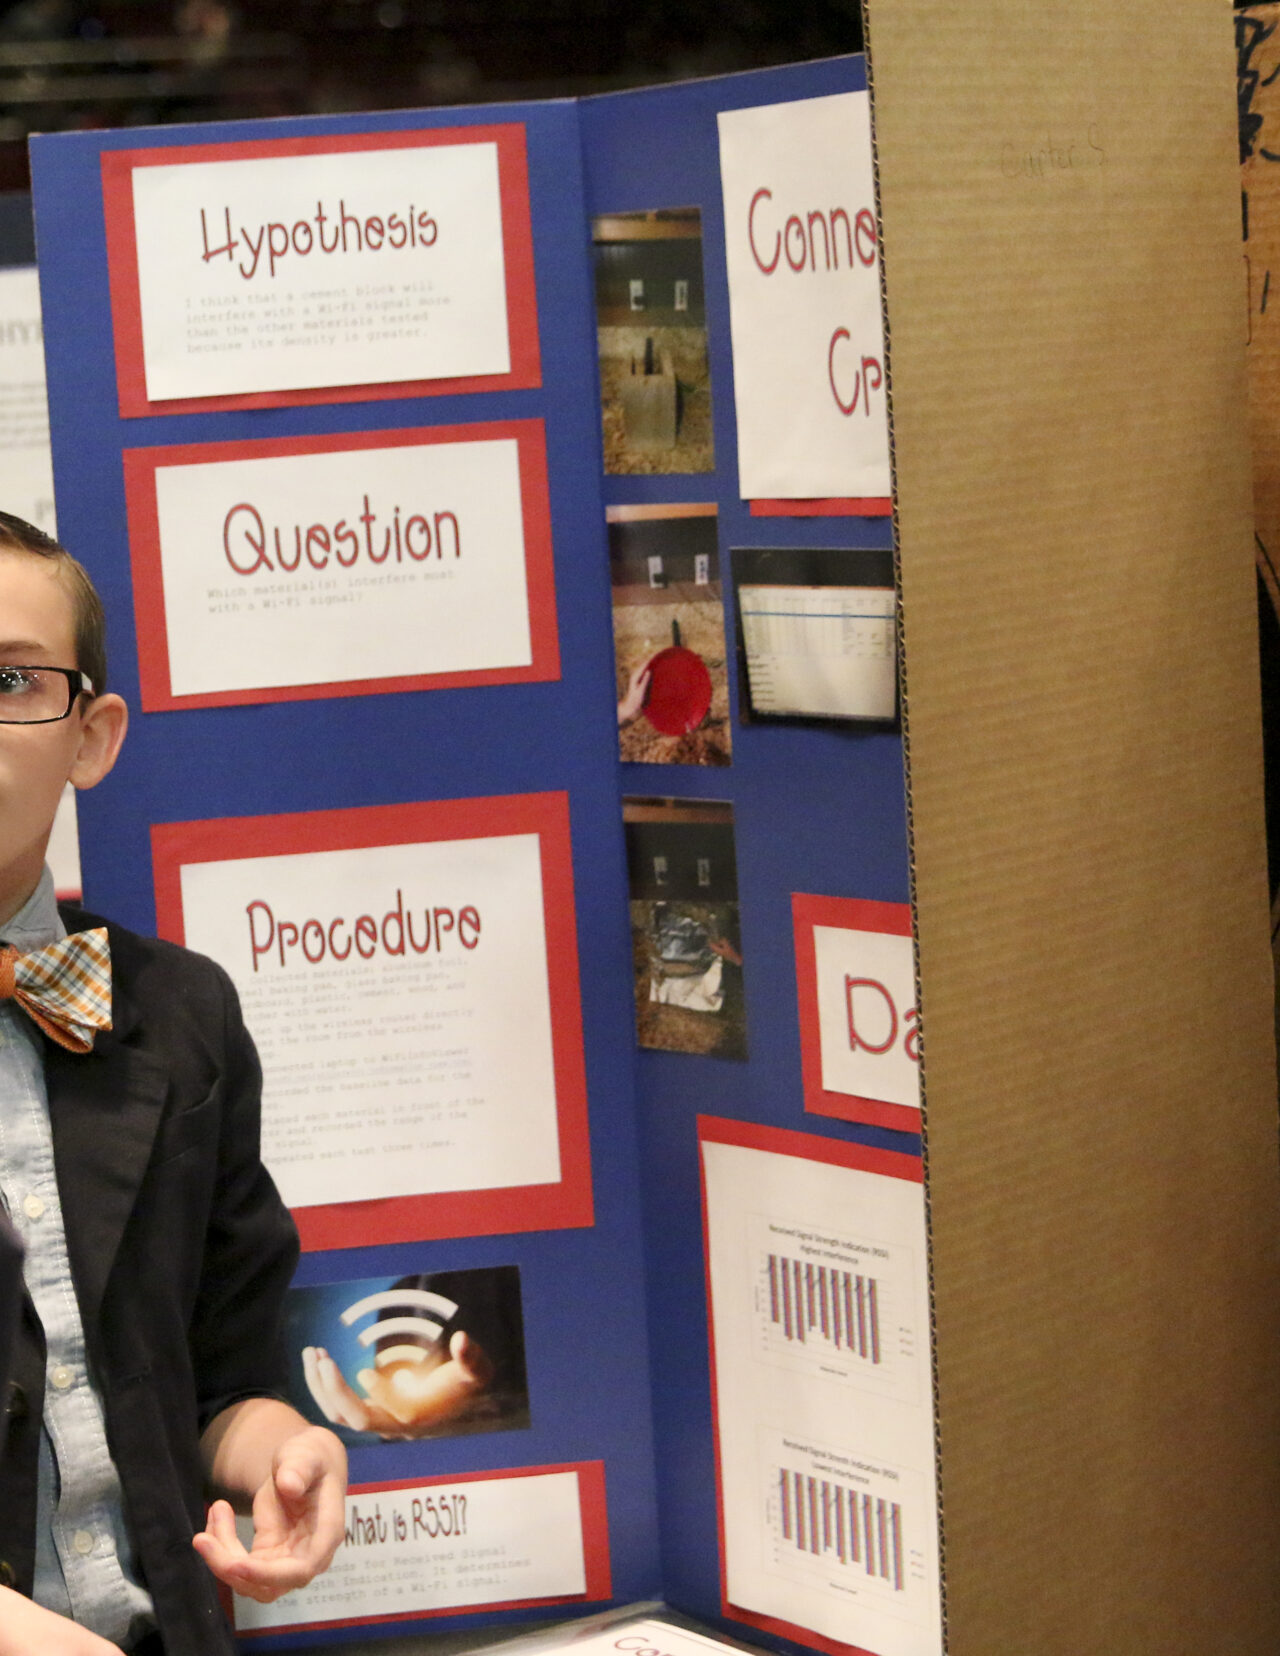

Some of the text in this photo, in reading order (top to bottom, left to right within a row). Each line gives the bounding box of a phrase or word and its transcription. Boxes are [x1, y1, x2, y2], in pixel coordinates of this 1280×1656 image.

[200, 199, 438, 280] Hypothesis
[200, 295, 239, 308] think
[247, 292, 277, 305] that
[301, 287, 347, 300] cement
[356, 283, 394, 296] block
[402, 281, 433, 293] will
[187, 310, 256, 324] interfere
[264, 306, 295, 318] with
[366, 297, 411, 312] signal
[419, 295, 451, 307] more
[187, 311, 428, 339] than the other materials tested
[187, 326, 428, 354] because its density is greater.
[223, 494, 460, 575] Question
[207, 569, 455, 600] Which material(s) interfere most
[208, 601, 239, 614] with
[246, 888, 481, 972] Procedure
[393, 1508, 407, 1542] is
[411, 1494, 467, 1541] RSSI?
[365, 1559, 386, 1569] for
[393, 1552, 455, 1566] Received
[462, 1545, 506, 1559] Signal
[306, 1589, 366, 1605] strength
